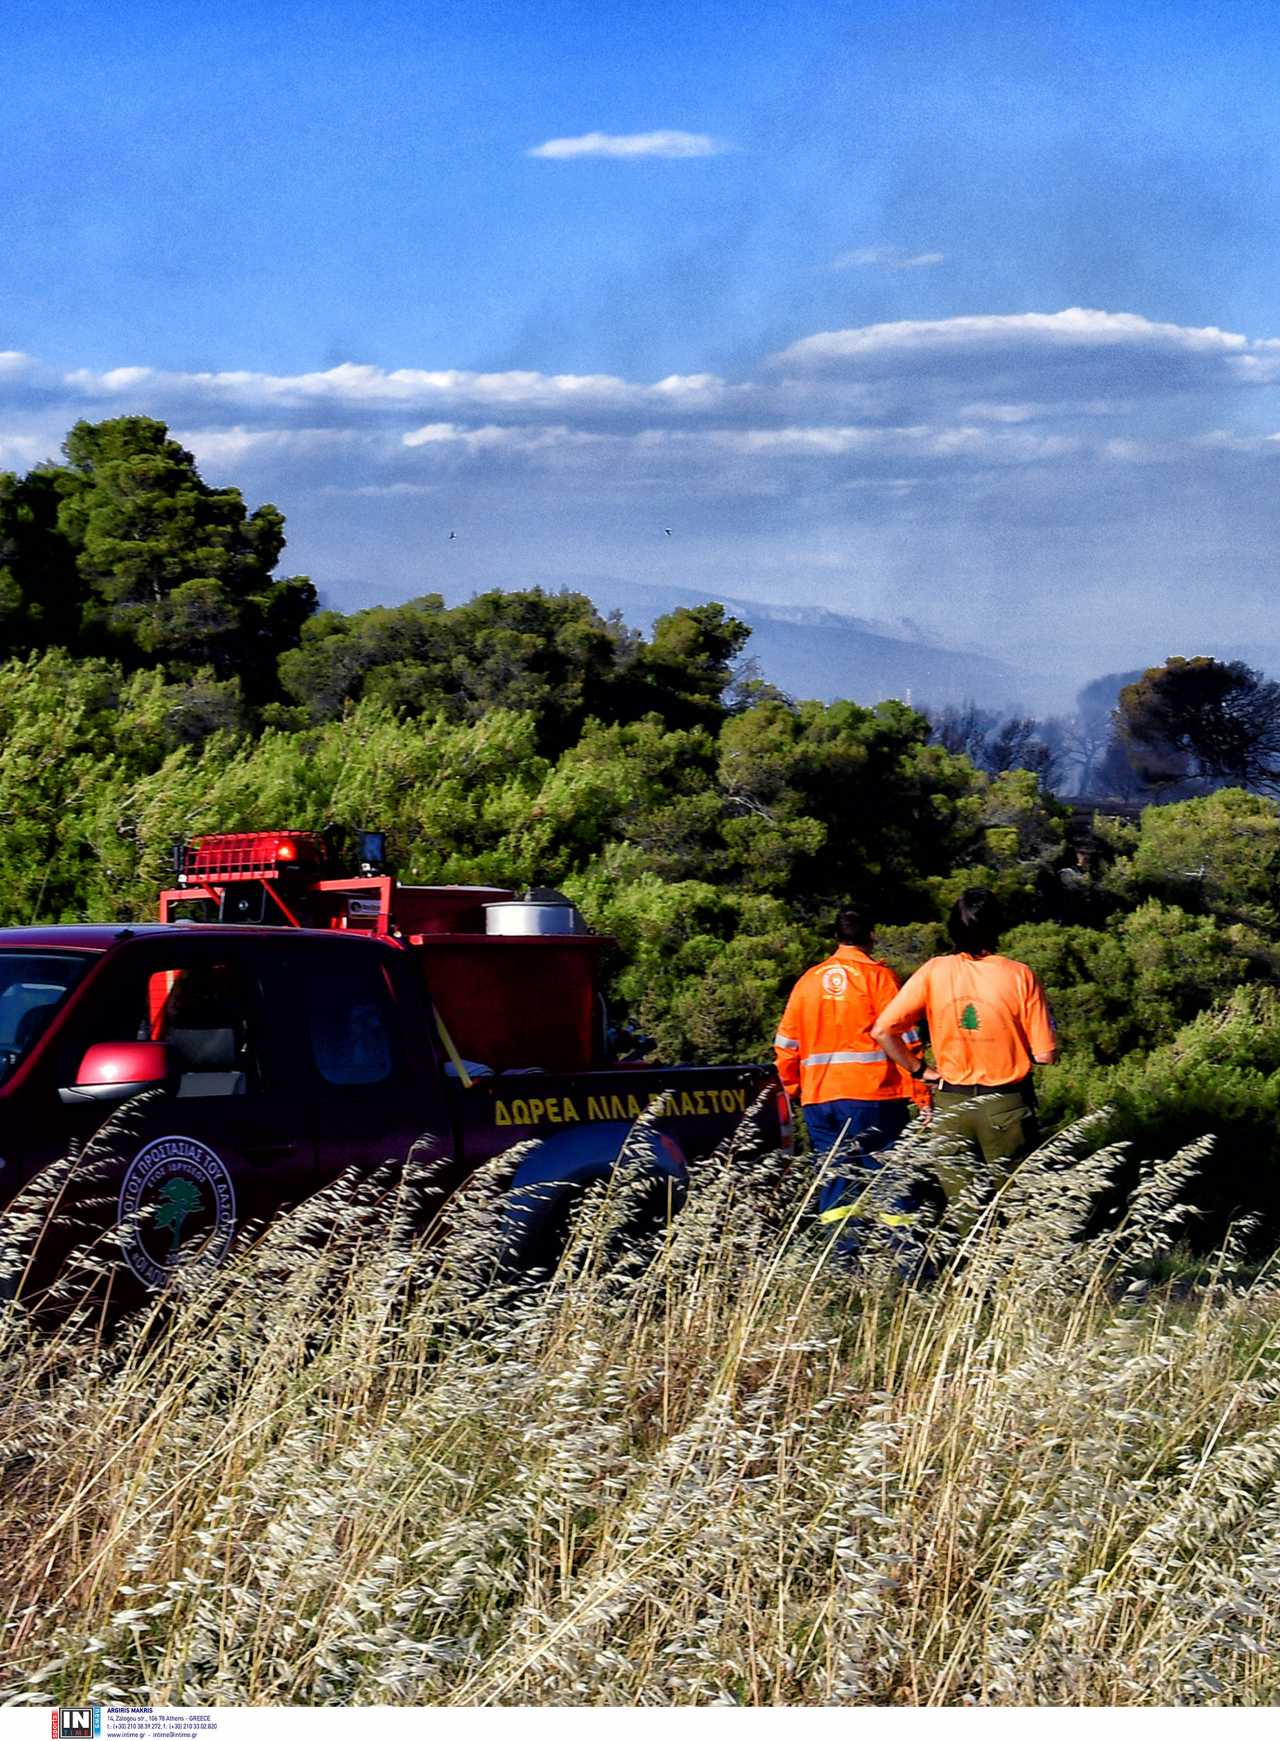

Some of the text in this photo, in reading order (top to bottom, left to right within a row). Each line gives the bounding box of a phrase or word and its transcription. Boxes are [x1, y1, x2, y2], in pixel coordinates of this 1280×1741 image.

[495, 1096, 581, 1126] ΔΩΡΕΑ
[586, 1094, 642, 1121] ΛΙΛΑ
[138, 1142, 204, 1175] ΠΡΟΣΤΑΣΙΑΣ
[203, 1155, 224, 1179] ΤΟΥ
